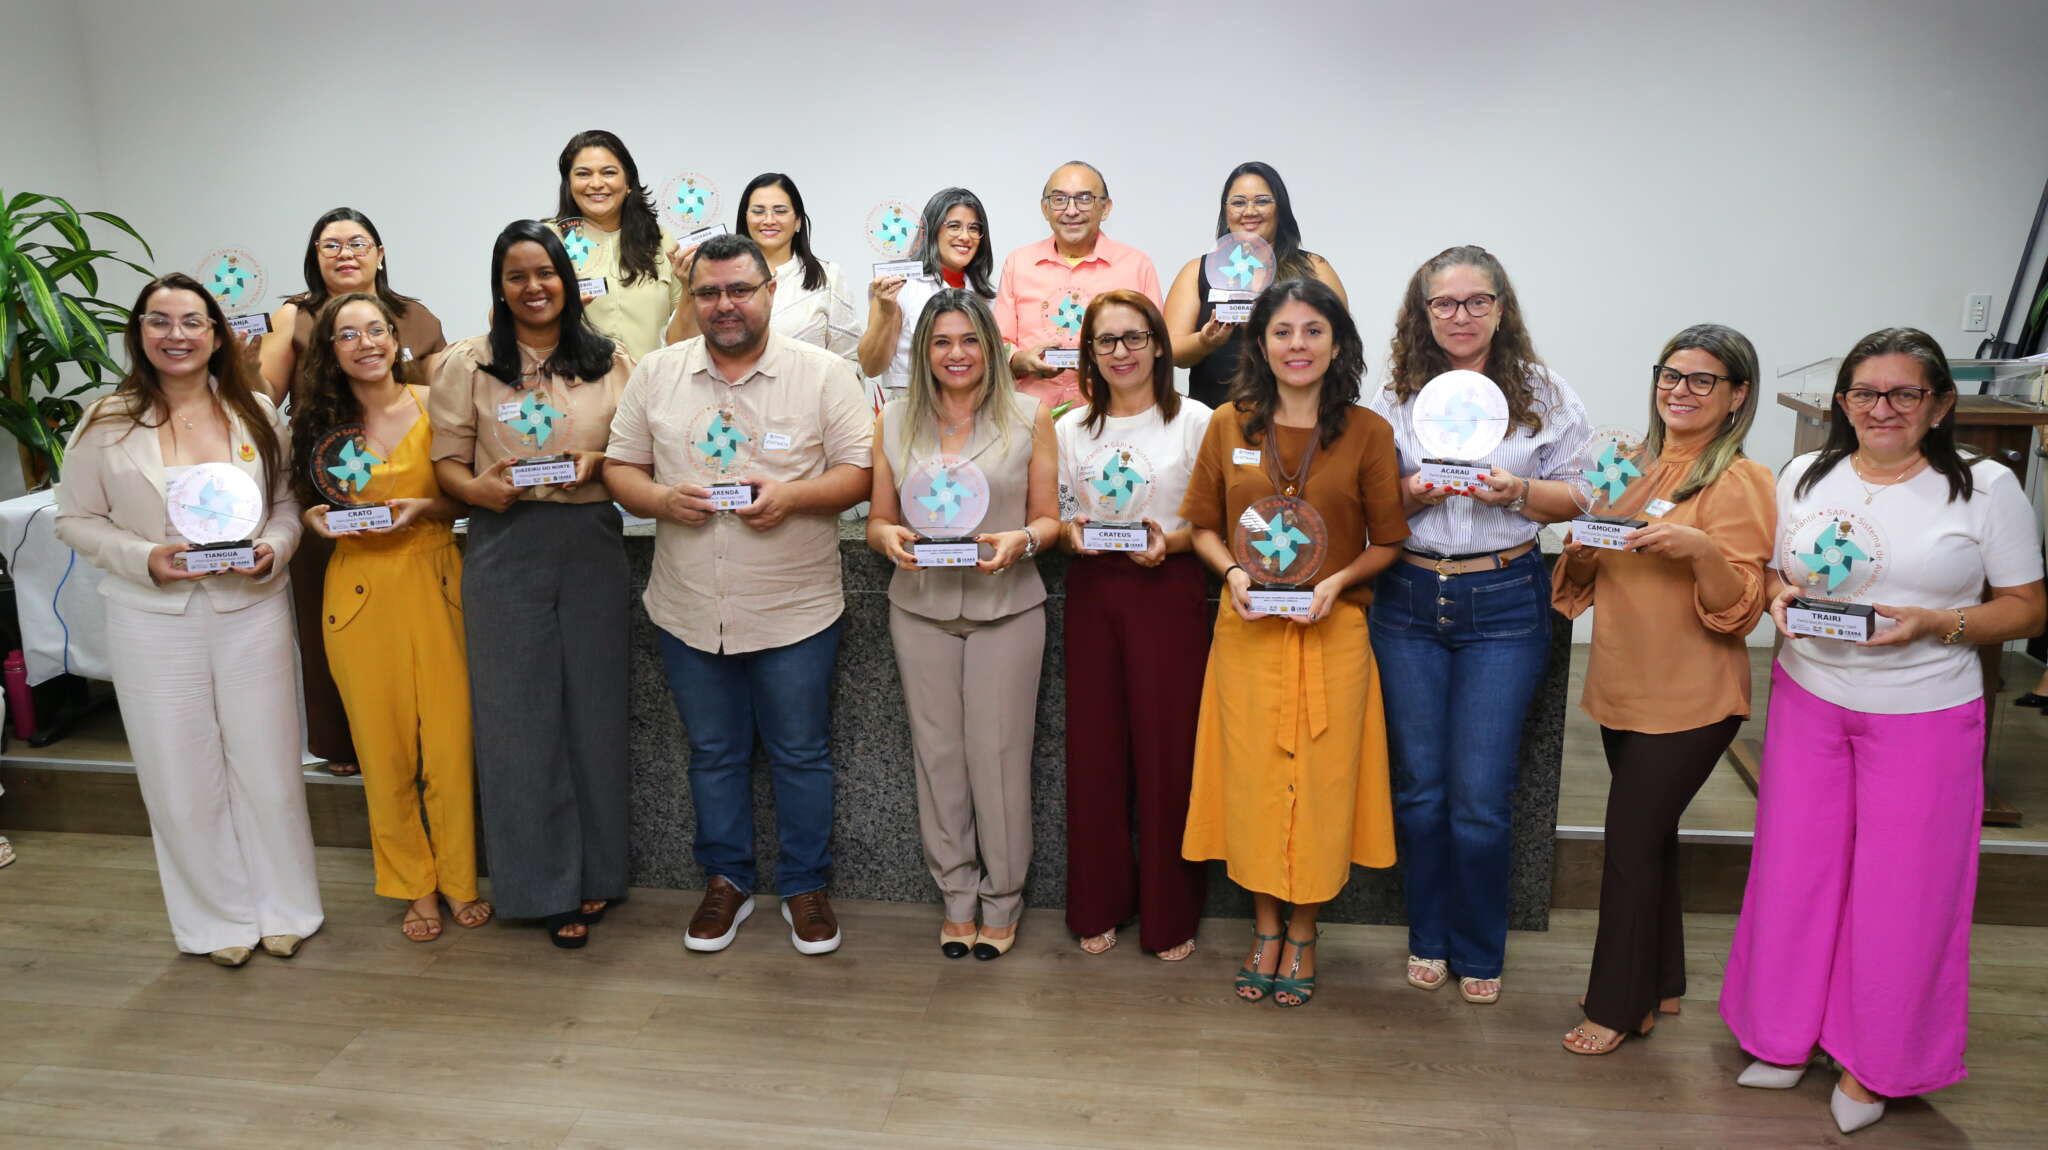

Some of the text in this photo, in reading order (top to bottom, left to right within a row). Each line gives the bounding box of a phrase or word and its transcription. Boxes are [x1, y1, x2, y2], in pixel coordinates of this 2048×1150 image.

[347, 509, 373, 517] CRATO
[1587, 524, 1621, 533] CAMOCIM
[1811, 612, 1841, 622] TRAIRI
